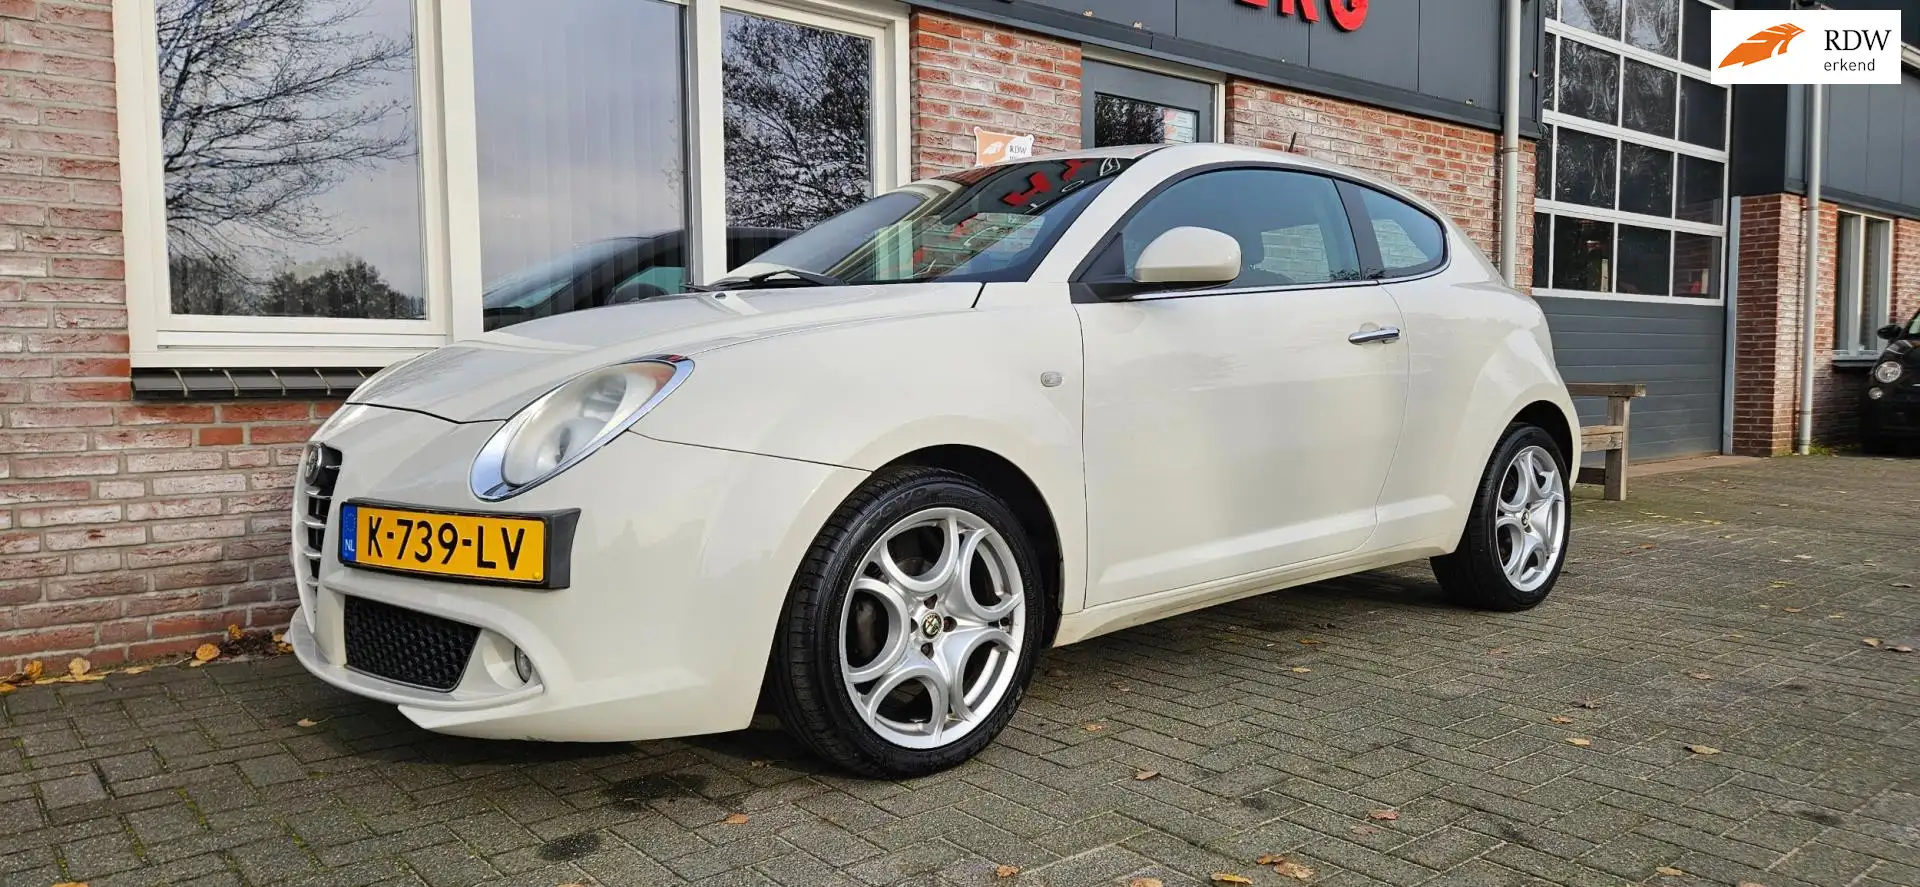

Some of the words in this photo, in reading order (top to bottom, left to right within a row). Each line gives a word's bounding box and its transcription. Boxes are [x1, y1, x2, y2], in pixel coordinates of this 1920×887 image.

[1009, 145, 1027, 154] RDW
[345, 539, 355, 552] NL
[367, 516, 526, 571] K-739-LV
